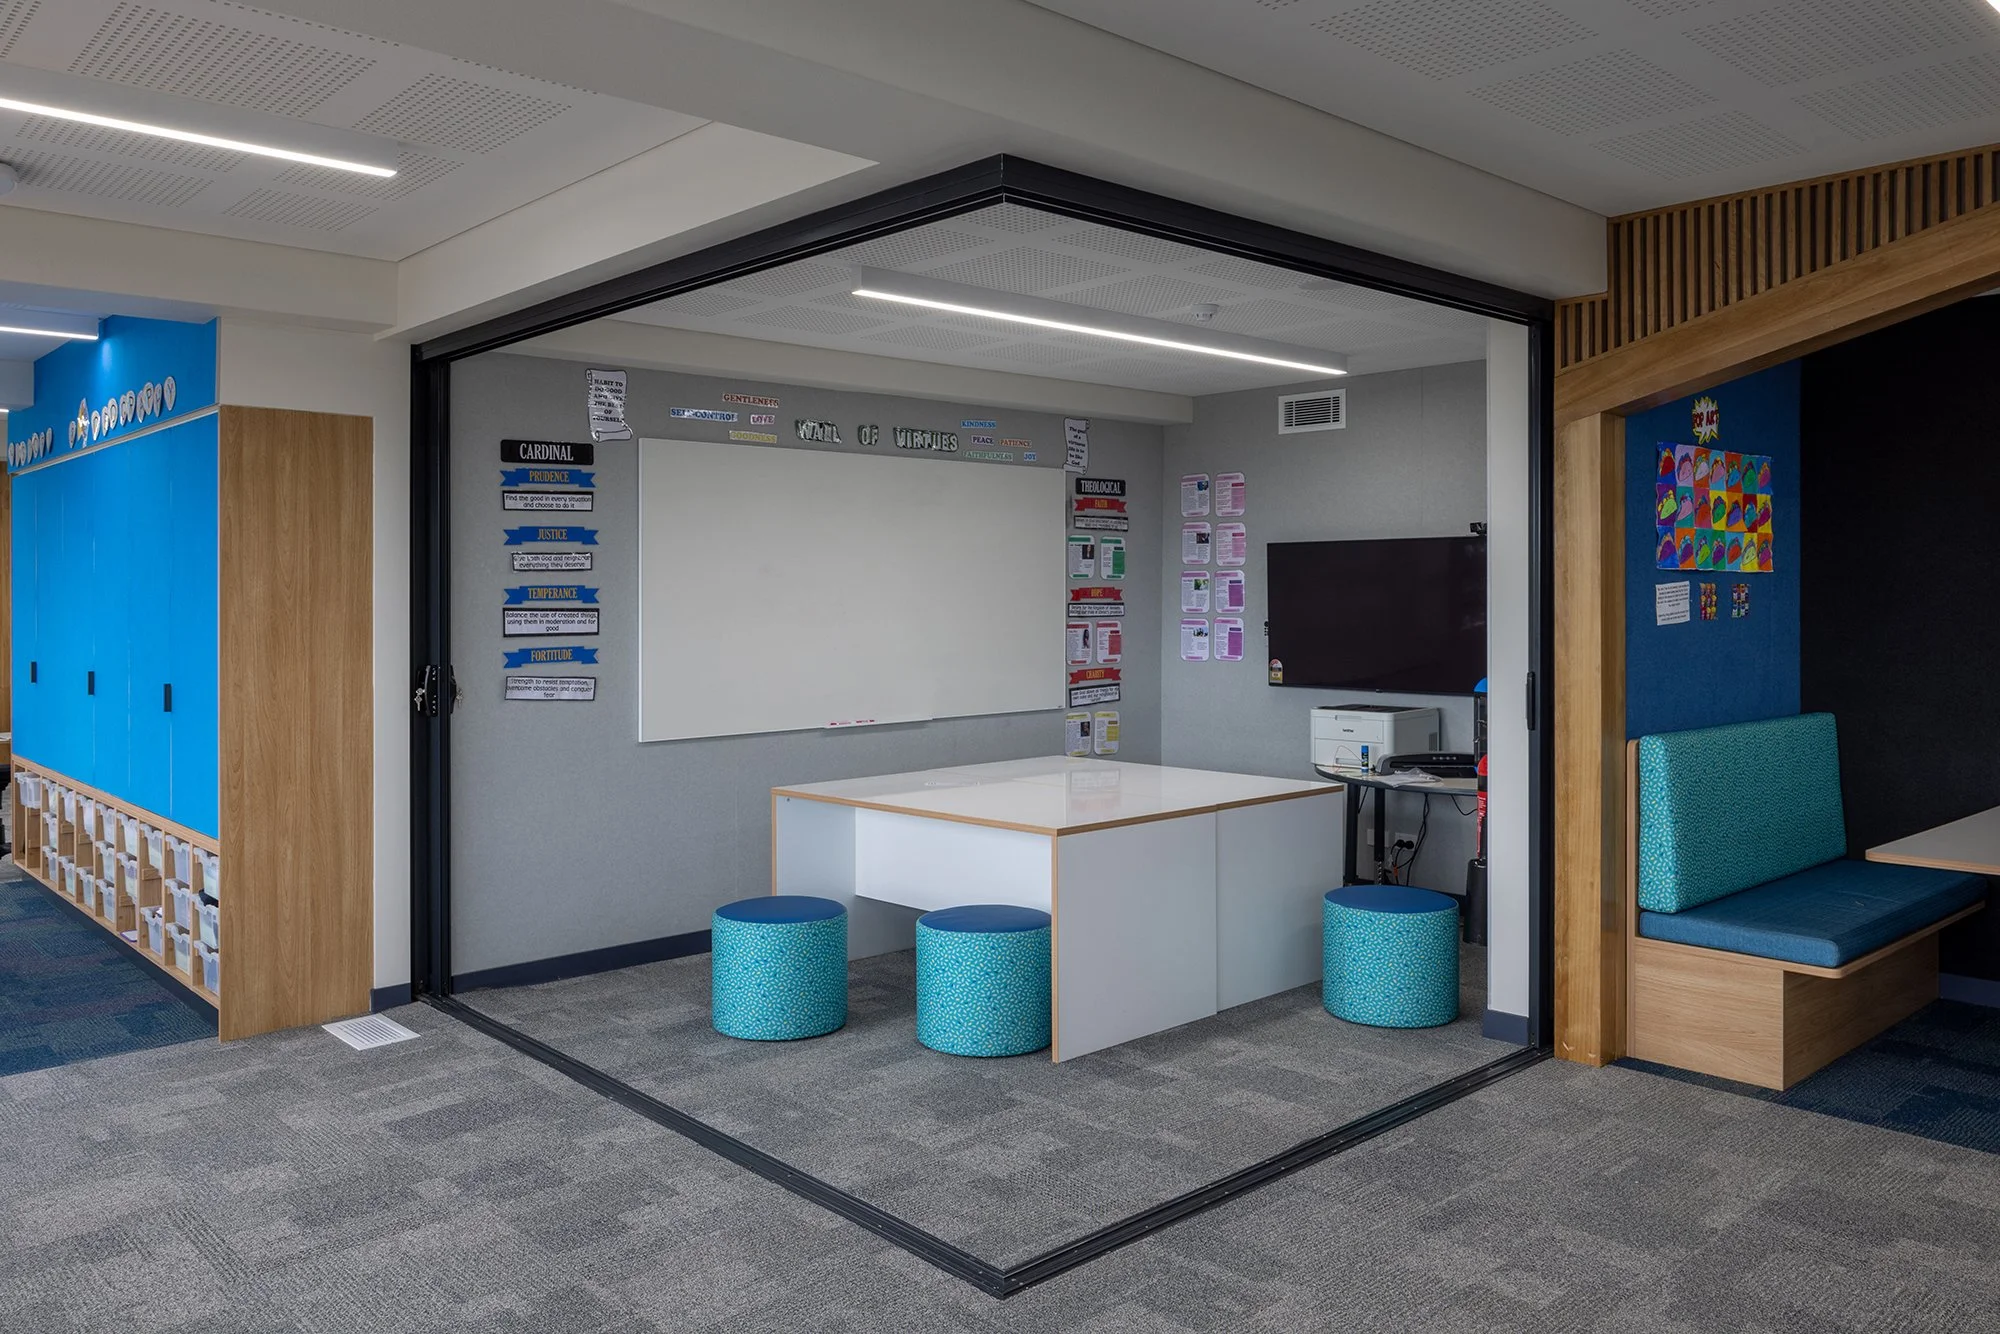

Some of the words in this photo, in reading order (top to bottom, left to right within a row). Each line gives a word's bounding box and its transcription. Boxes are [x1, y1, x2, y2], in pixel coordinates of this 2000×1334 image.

[858, 425, 879, 446] OF
[894, 427, 959, 452] VIRTUES
[520, 443, 574, 461] CARDINAL
[529, 470, 570, 482] PRUDENCE
[1081, 480, 1121, 494] THEOLOGICAL
[537, 529, 568, 540] JUSTICE
[528, 587, 578, 599] TEMPERANCE
[531, 649, 573, 662] FORTITUDE
